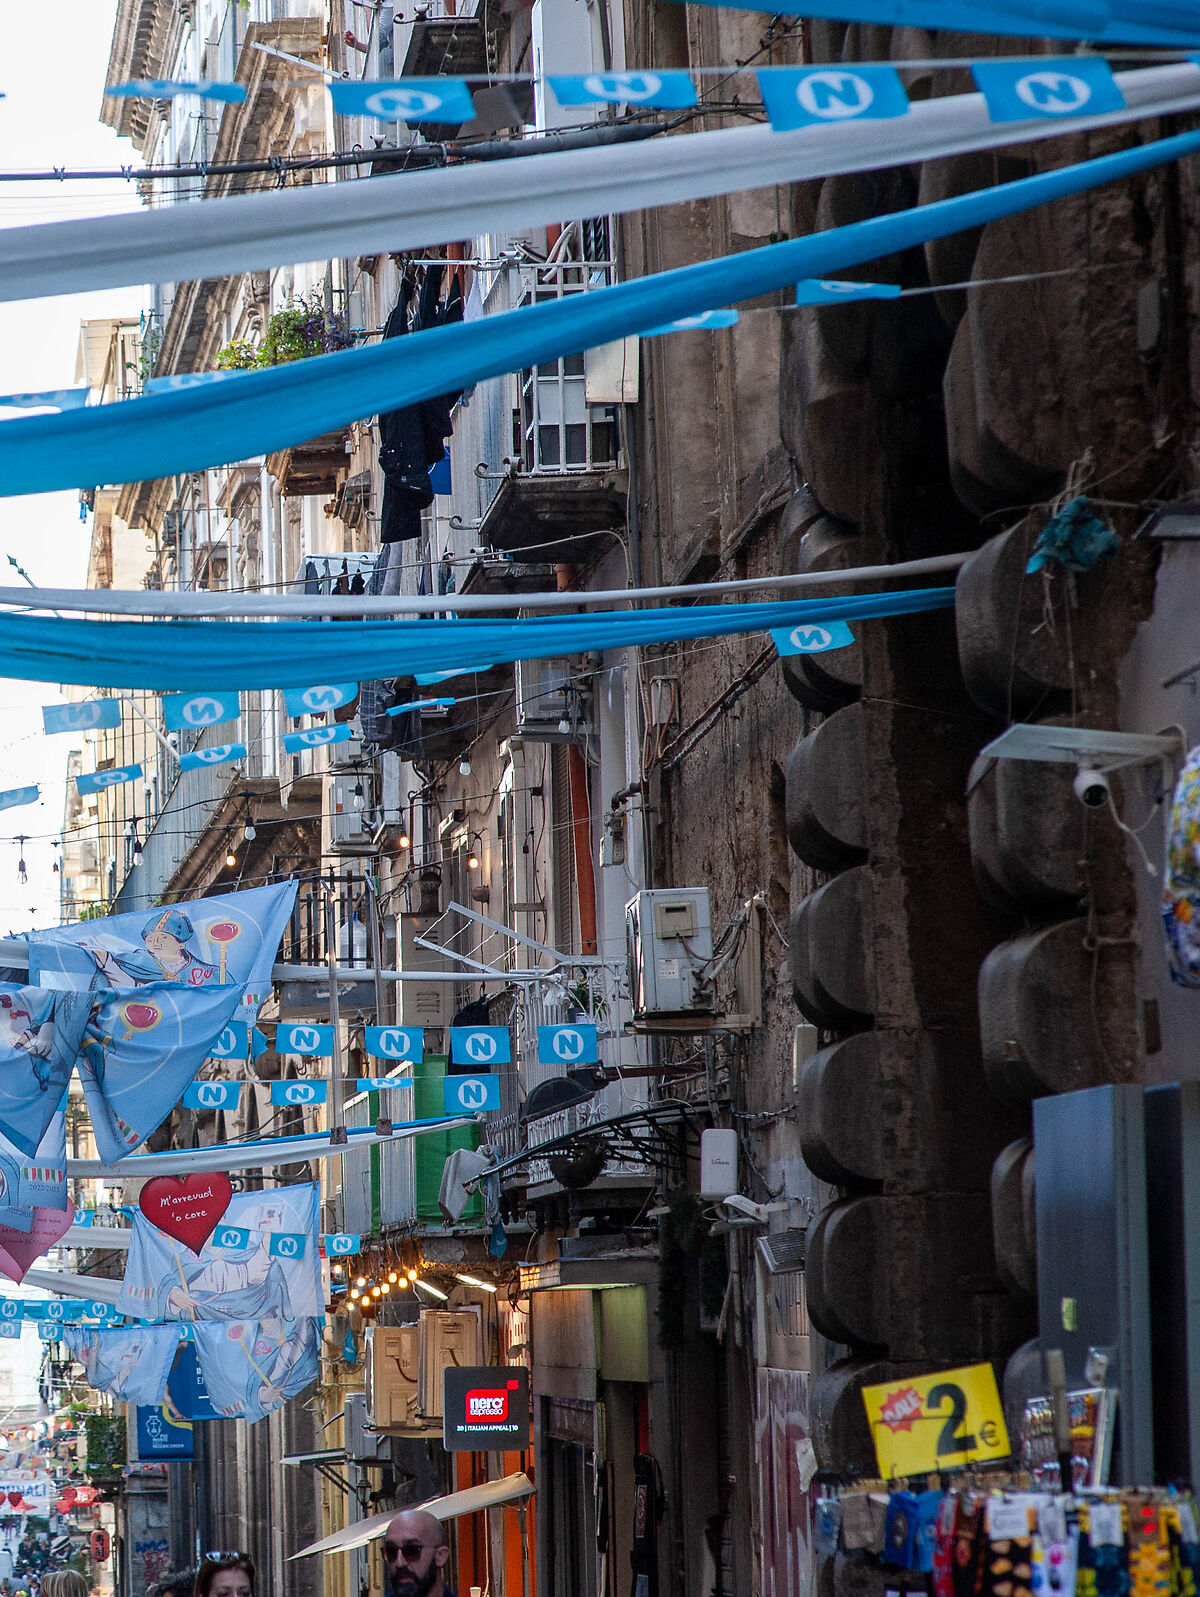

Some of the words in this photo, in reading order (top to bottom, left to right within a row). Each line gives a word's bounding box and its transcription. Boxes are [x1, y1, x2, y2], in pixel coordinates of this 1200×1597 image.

[594, 73, 650, 95] N
[1024, 76, 1083, 107] N
[374, 91, 433, 116] N
[805, 76, 865, 114] N
[203, 746, 226, 759] N
[97, 773, 124, 783] N
[293, 1027, 317, 1048] N
[383, 1033, 407, 1054] N
[556, 1033, 581, 1056] N
[469, 1037, 493, 1058] N
[201, 1085, 224, 1103] N
[289, 1086, 311, 1101] N
[461, 1083, 484, 1105] N
[184, 1209, 208, 1220] core
[223, 1232, 239, 1244] N
[280, 1239, 295, 1253] N
[335, 1239, 350, 1250] N
[470, 1397, 504, 1409] nero
[470, 1408, 504, 1416] espresso
[927, 1383, 978, 1456] 2
[980, 1421, 1000, 1447] €
